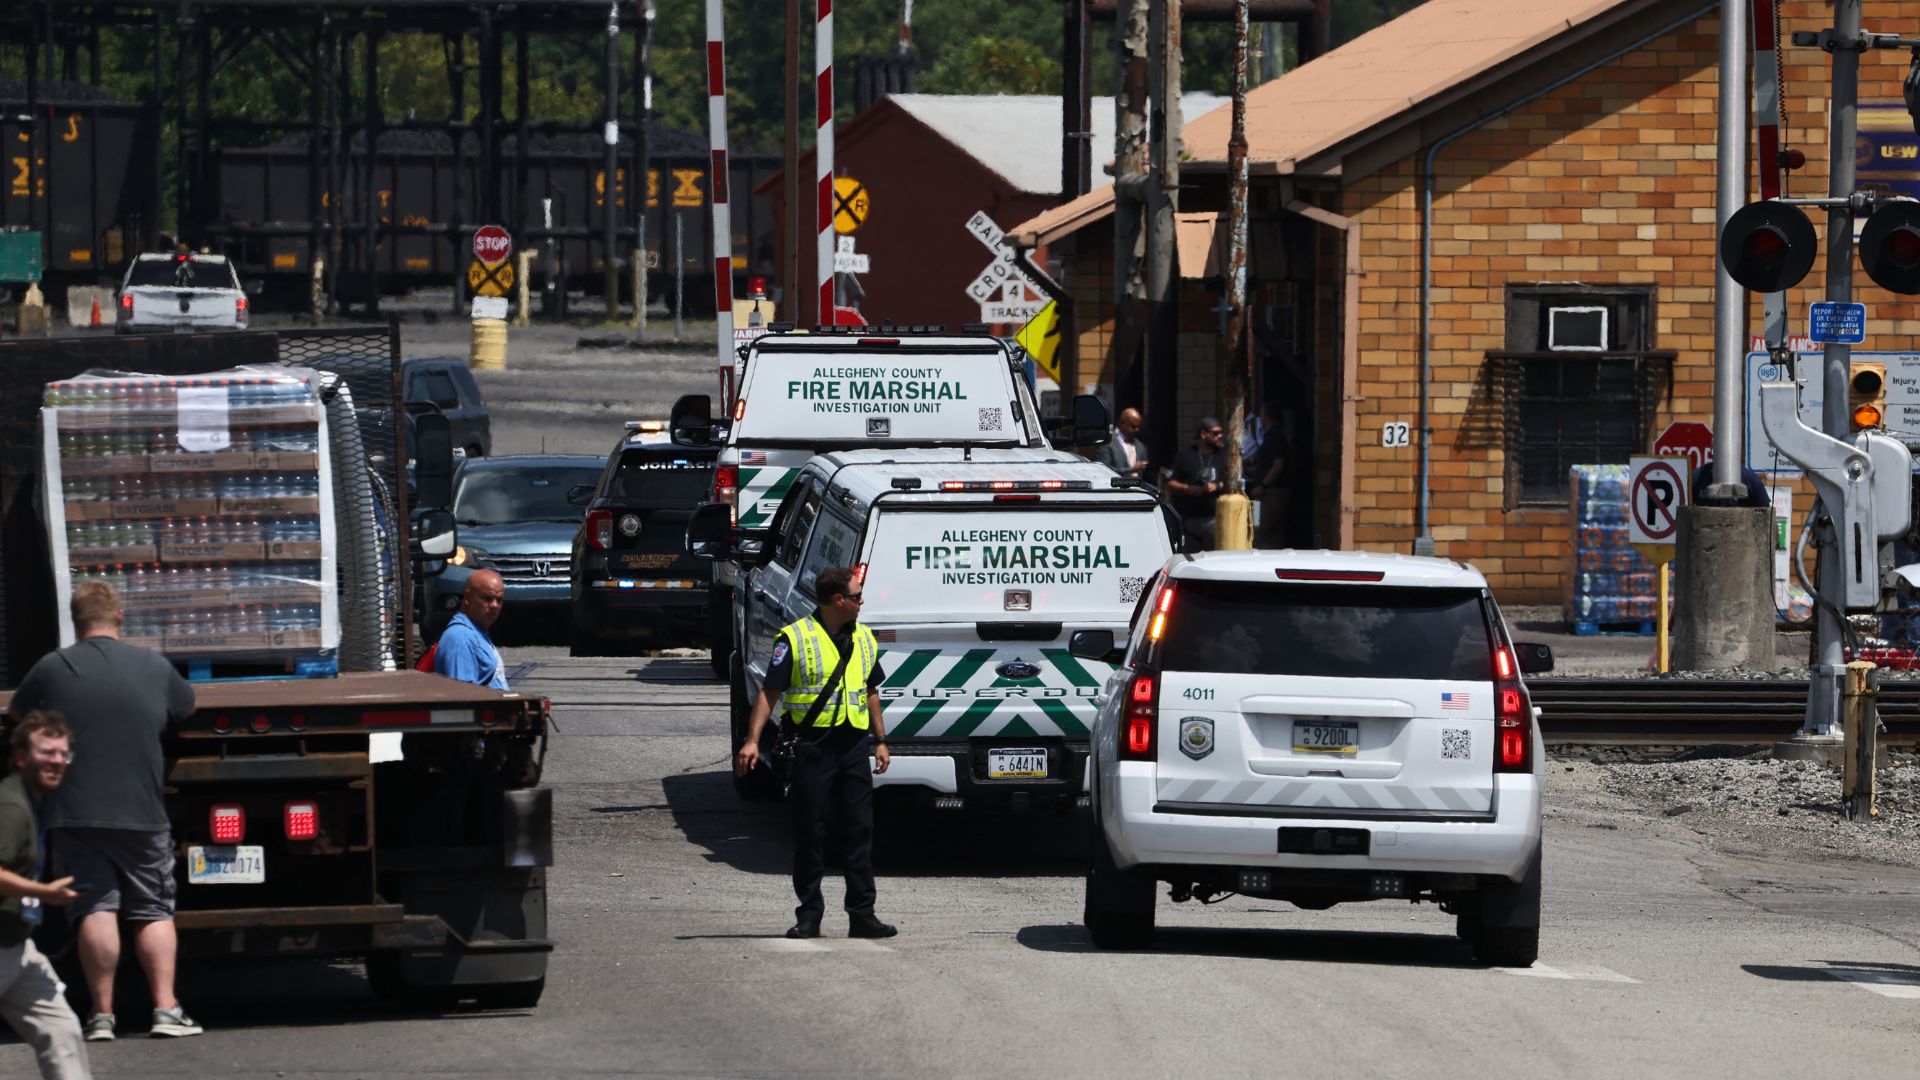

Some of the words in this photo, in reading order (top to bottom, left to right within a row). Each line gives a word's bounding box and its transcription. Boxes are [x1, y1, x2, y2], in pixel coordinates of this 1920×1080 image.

[1881, 145, 1918, 158] USW
[477, 236, 508, 250] STOP
[842, 240, 850, 252] 2
[1009, 285, 1019, 296] 4
[991, 307, 1037, 318] TRACKS
[813, 367, 887, 378] ALLEGHENY
[891, 368, 942, 379] COUNTY
[1893, 376, 1916, 385] Injury
[788, 381, 841, 400] FIRE
[849, 381, 968, 400] MARSHAL
[813, 402, 910, 413] INVESTIGATION
[914, 402, 942, 413] UNIT
[1385, 425, 1407, 445] 32
[941, 530, 1027, 542] ALLEGHENY
[1033, 529, 1094, 542] COUNTY
[906, 546, 971, 569] FIRE
[983, 545, 1130, 568] MARSHAL
[942, 572, 1055, 584] INVESTIGATION
[1060, 572, 1093, 584] UNIT
[1004, 665, 1032, 677] Ford
[880, 687, 1029, 698] SUPER
[1043, 687, 1099, 698] DU
[1183, 687, 1215, 700] 4011
[1314, 727, 1353, 746] 9200L
[1009, 756, 1044, 772] 6441N
